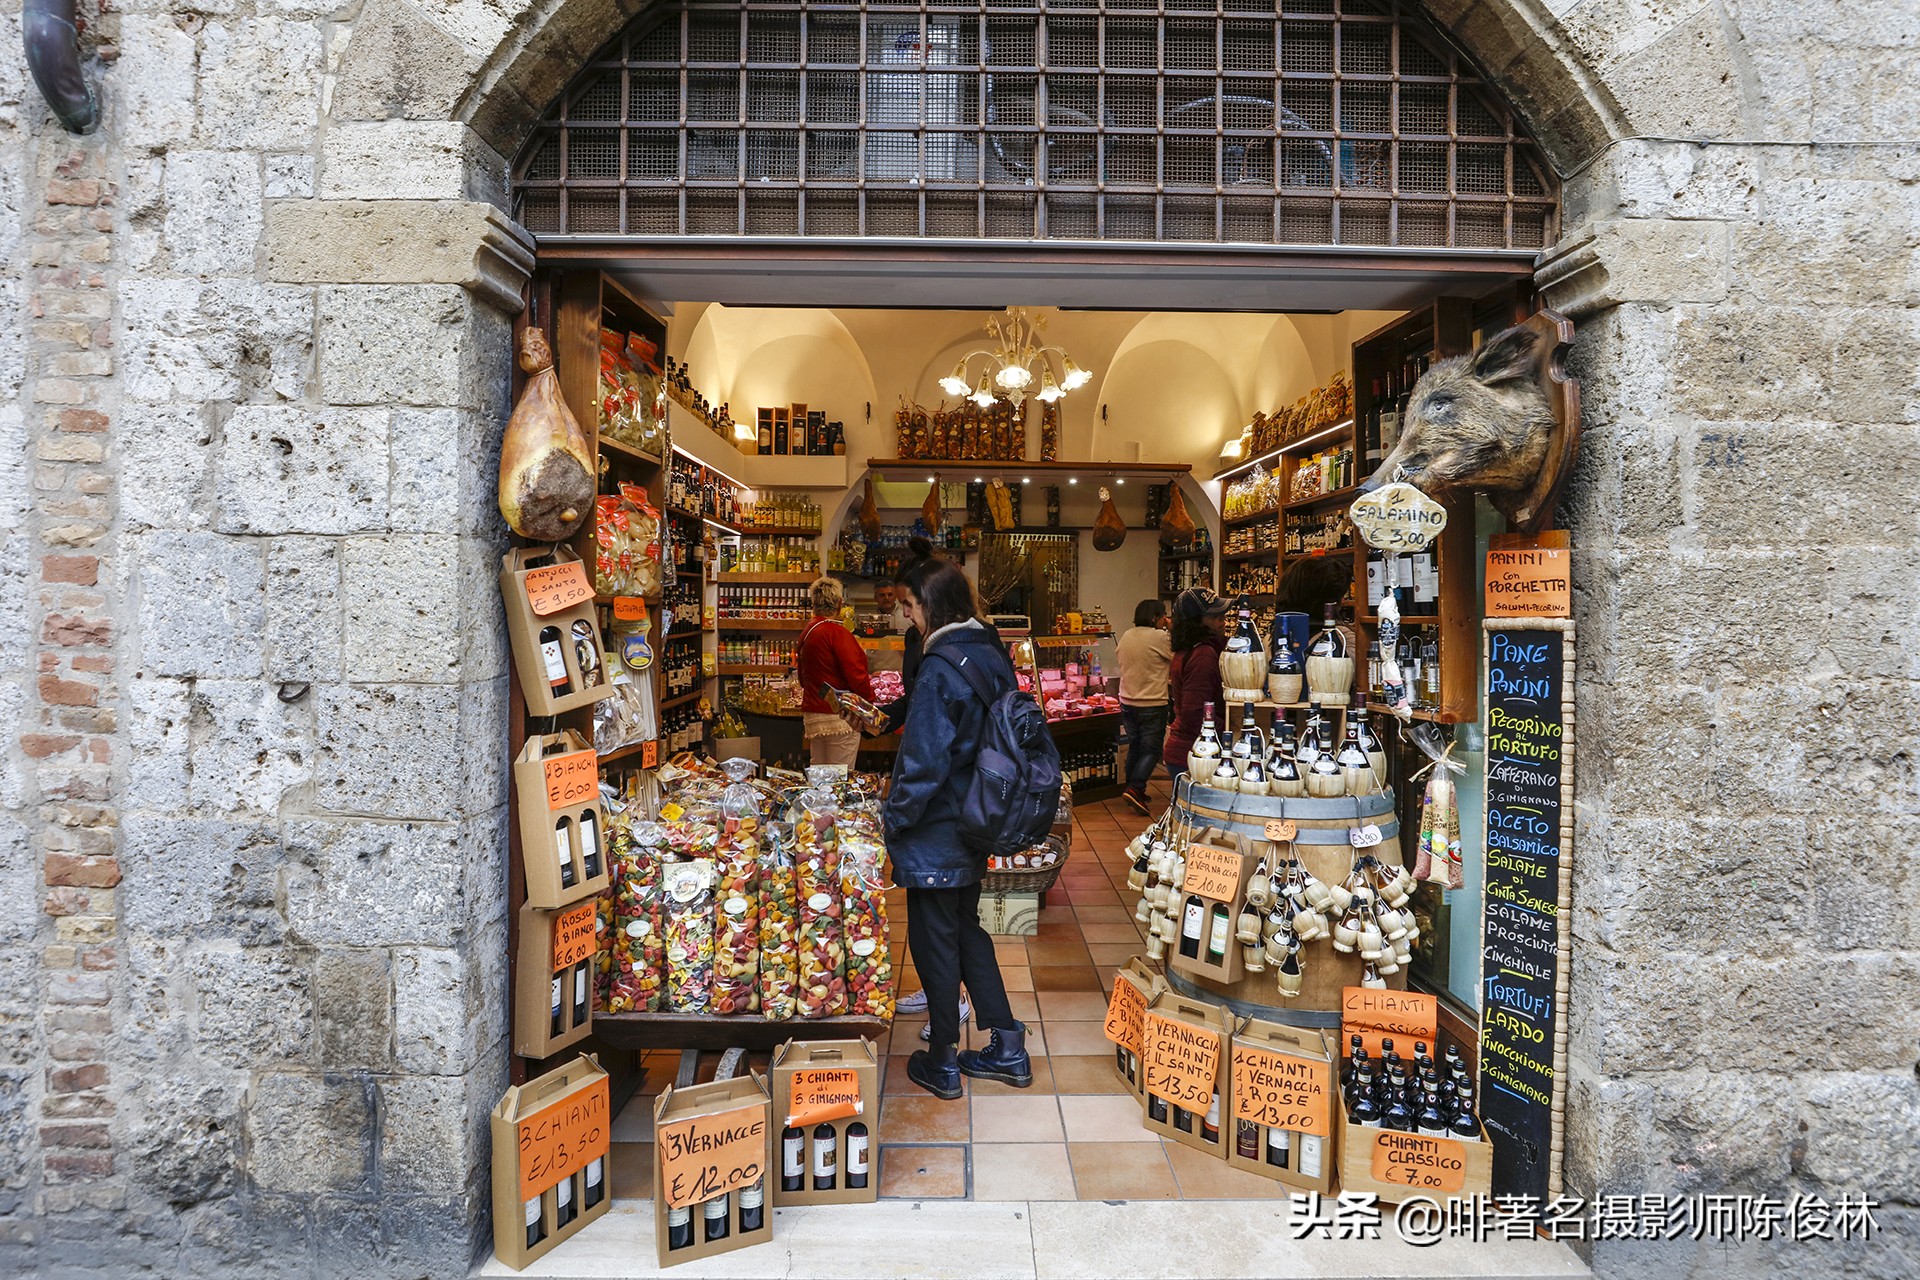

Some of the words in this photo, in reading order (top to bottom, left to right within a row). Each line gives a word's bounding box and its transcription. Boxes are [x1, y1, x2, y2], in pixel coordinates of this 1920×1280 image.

[1391, 490, 1405, 505] 1
[1356, 505, 1443, 525] SALAMINO
[1390, 529, 1425, 547] 3,00
[1490, 553, 1543, 565] PANINI
[542, 578, 577, 592] SANTO
[1488, 579, 1566, 593] PORCHETTA
[1492, 634, 1549, 663] PANE
[1515, 732, 1527, 741] AL
[1489, 734, 1559, 761] TARTUFO
[1488, 758, 1557, 787] ZAFFERANO
[1489, 810, 1549, 835] ACETO
[1488, 849, 1547, 879] SALAME
[562, 908, 592, 928] ROSSO
[1486, 904, 1552, 932] SALAME
[562, 923, 594, 944] BIANCO
[1146, 1016, 1153, 1031] 1
[1157, 1020, 1219, 1053] VERNACCIA
[1486, 1007, 1545, 1044] LARDO
[1145, 1035, 1152, 1048] 1
[1157, 1041, 1216, 1070] CHIANTI
[1144, 1049, 1150, 1062] 1
[1155, 1052, 1164, 1065] IL
[1167, 1059, 1212, 1081] SANTO
[1236, 1069, 1243, 1082] 1
[795, 1073, 803, 1084] 3
[808, 1072, 853, 1083] CHIANTI
[1159, 1073, 1209, 1104] 13,50
[809, 1094, 859, 1104] GIMIGNANO
[1236, 1083, 1243, 1096] 1
[1249, 1086, 1309, 1107] ROSE
[1253, 1104, 1314, 1127] 13,00
[1378, 1133, 1439, 1154] CHIANTI
[1388, 1150, 1461, 1171] CLASSICO
[688, 1164, 758, 1200] 12,00
[1385, 1166, 1398, 1182] €
[1405, 1168, 1442, 1187] 7,00
